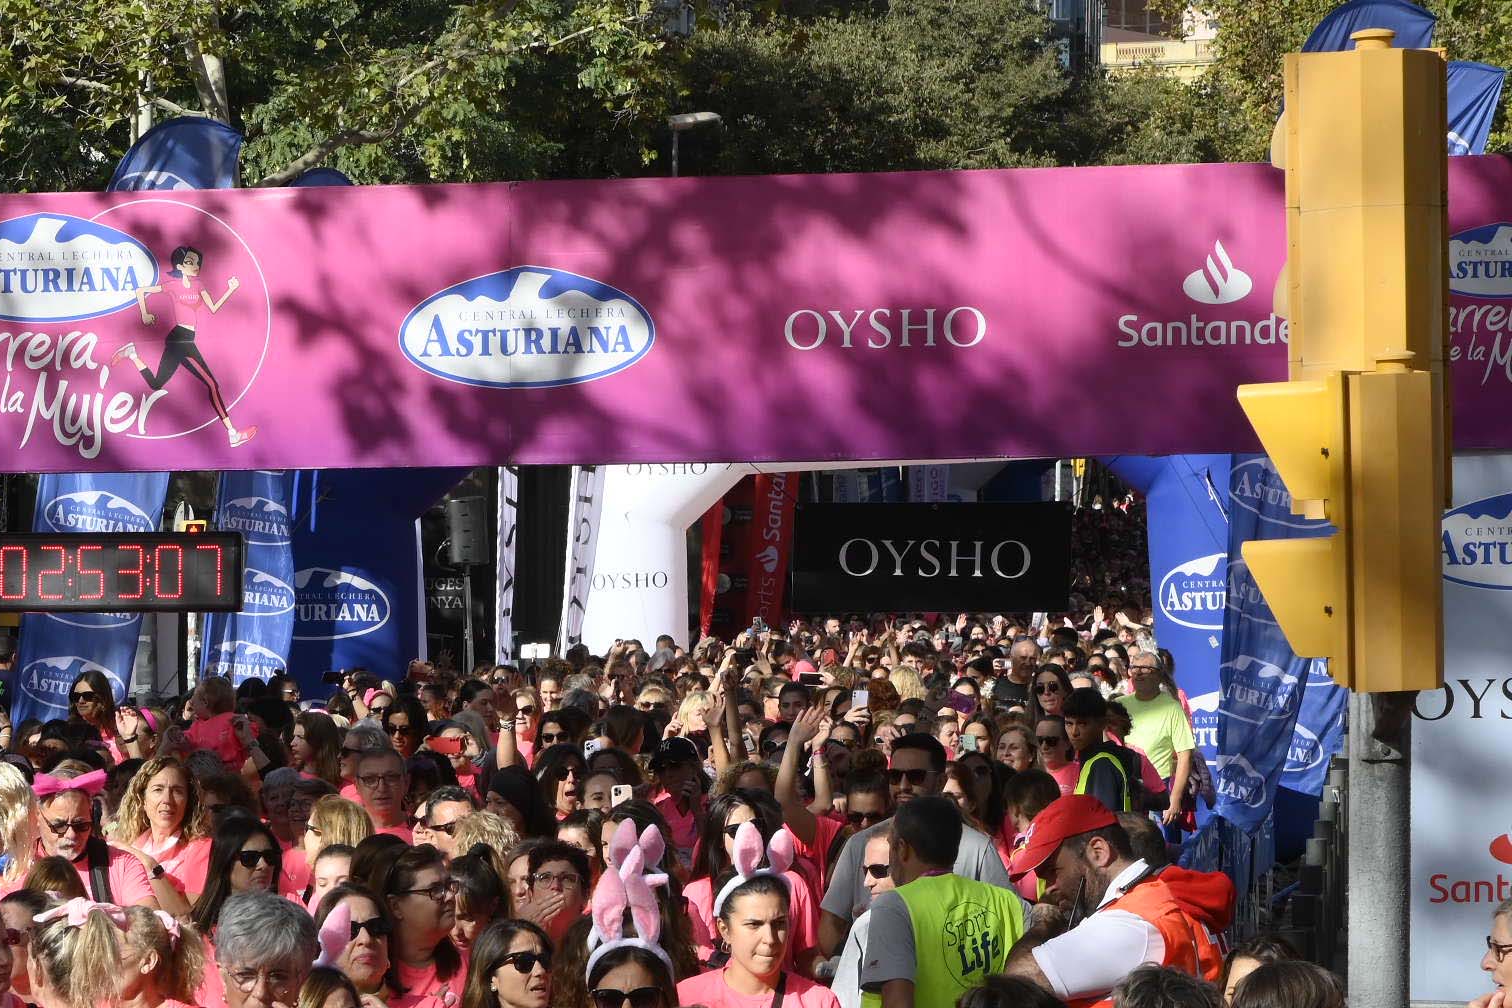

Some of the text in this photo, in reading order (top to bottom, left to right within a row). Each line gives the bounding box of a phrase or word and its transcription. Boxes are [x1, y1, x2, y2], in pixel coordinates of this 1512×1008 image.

[62, 250, 135, 262] LECHERA
[457, 307, 626, 321] CENTRAL LECHERA
[783, 307, 988, 351] OYSHO
[1117, 312, 1288, 348] Santande
[418, 313, 636, 358] ASTURIANA
[0, 374, 25, 414] la
[19, 365, 169, 460] Mujer
[0, 545, 222, 600] 02:53:07
[838, 538, 1032, 579] OYSHO
[591, 571, 668, 591] OYSHO
[1165, 582, 1226, 611] ASTU
[1182, 580, 1225, 588] CENTRA
[245, 591, 289, 609] RIANA
[295, 603, 381, 622] TURIANA
[944, 911, 992, 947] Sport
[957, 930, 1001, 977] Life
